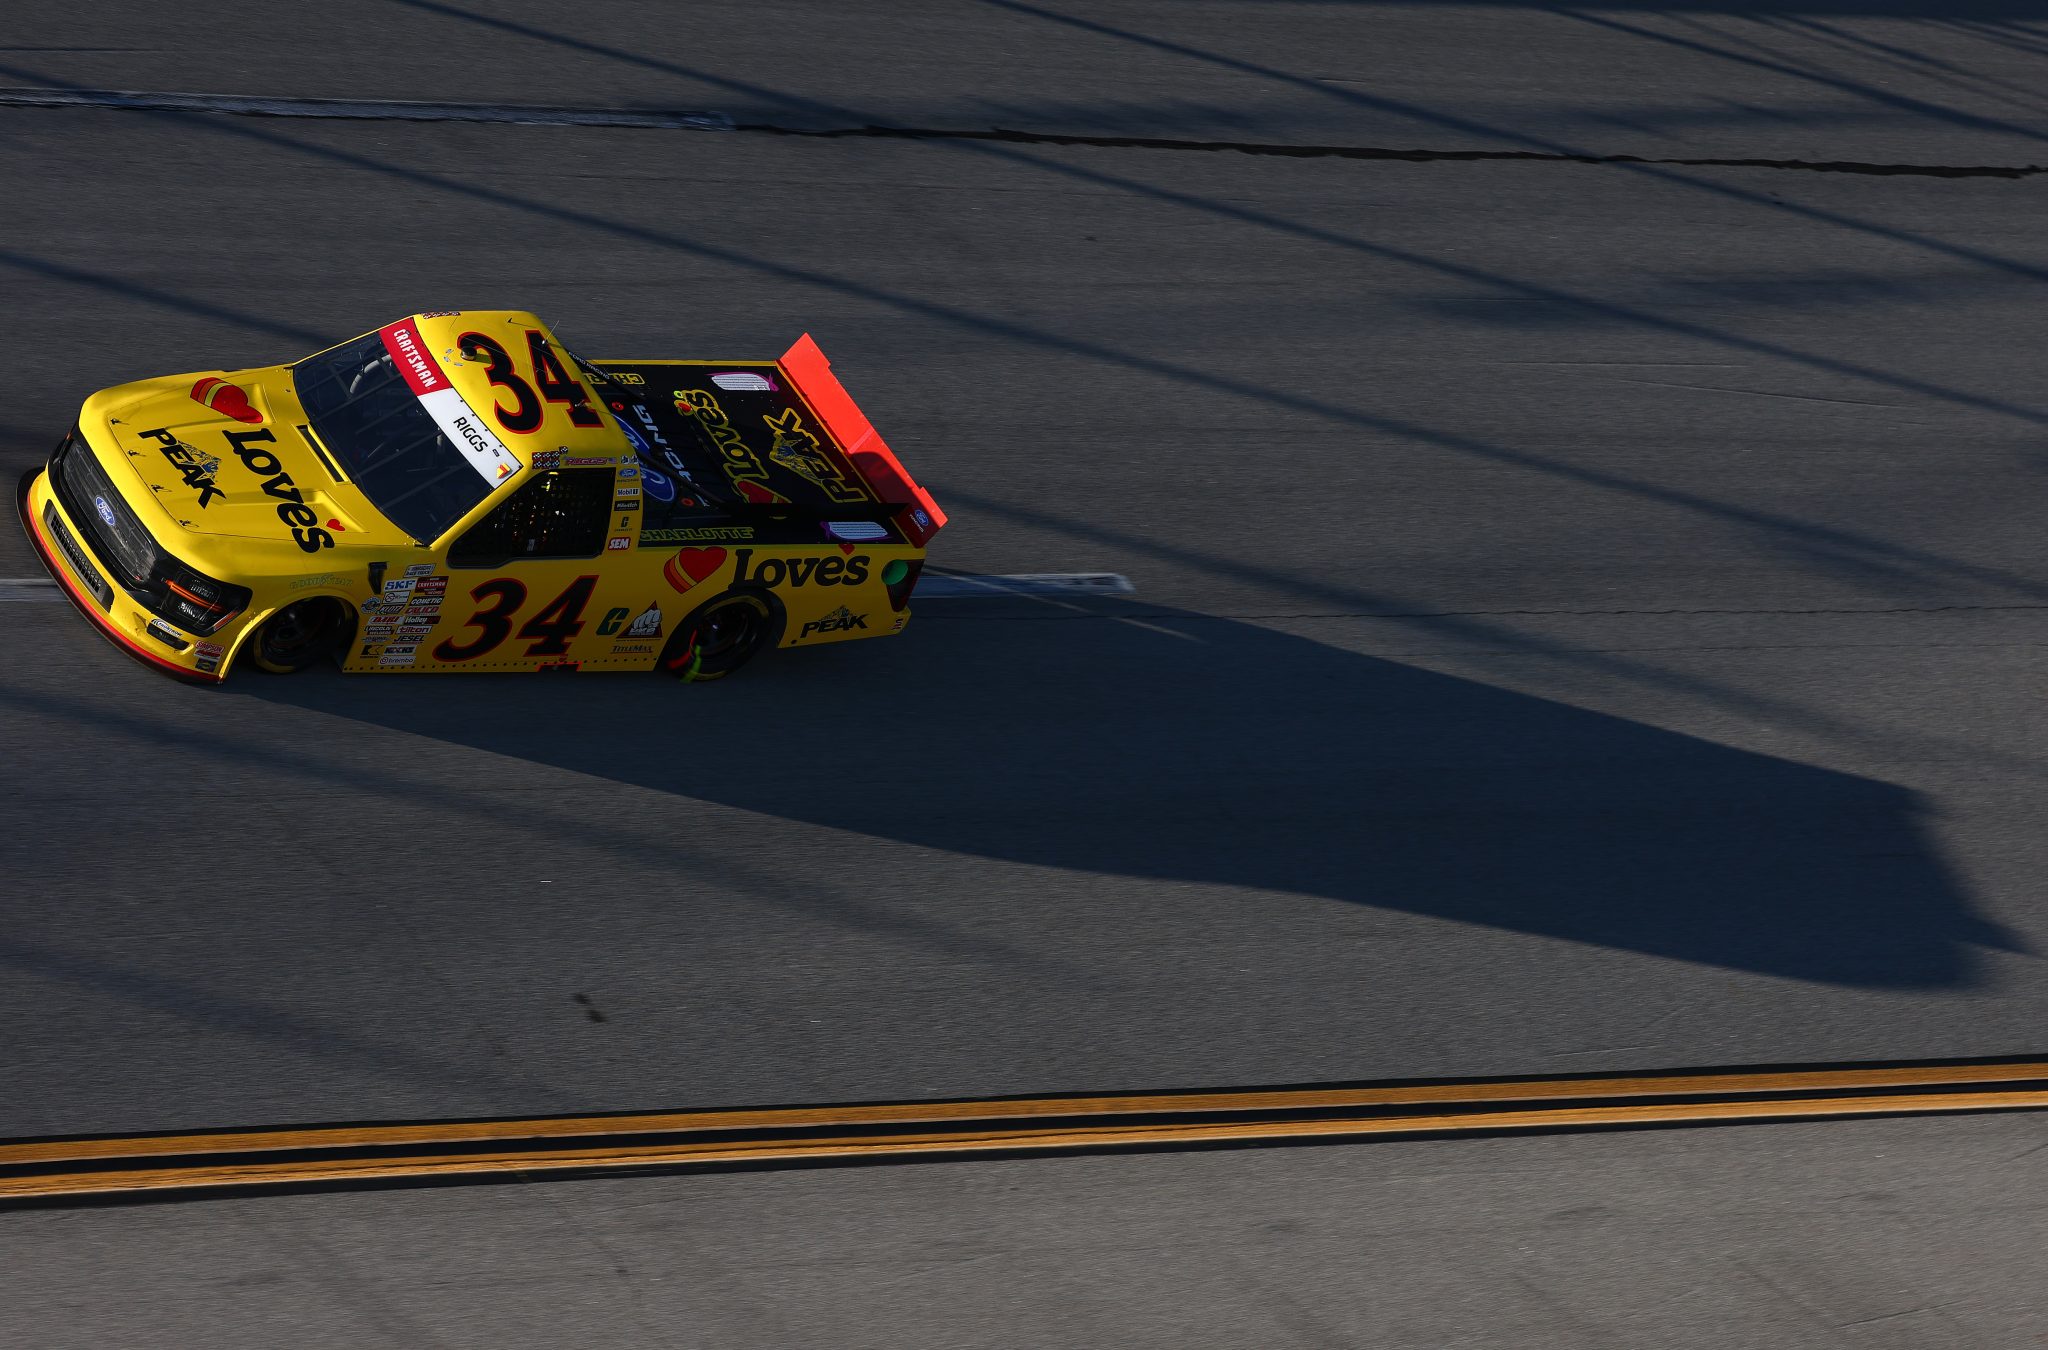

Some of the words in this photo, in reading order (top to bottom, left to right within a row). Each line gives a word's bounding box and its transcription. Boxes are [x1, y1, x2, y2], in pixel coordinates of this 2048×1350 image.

[393, 328, 437, 387] CRAFTSMAN
[457, 329, 604, 434] 34
[453, 416, 488, 453] RIGGS
[762, 407, 868, 503] PEAK
[138, 427, 227, 509] PEAK
[617, 488, 632, 496] Mobil
[609, 538, 630, 549] SEM
[640, 526, 755, 541] CHARLOTTE
[384, 579, 416, 590] SKF
[405, 616, 428, 625] Holley
[432, 575, 599, 661] 34
[800, 612, 869, 638] PEAK
[196, 640, 224, 654] SIMPSON
[394, 634, 425, 642] JESEL
